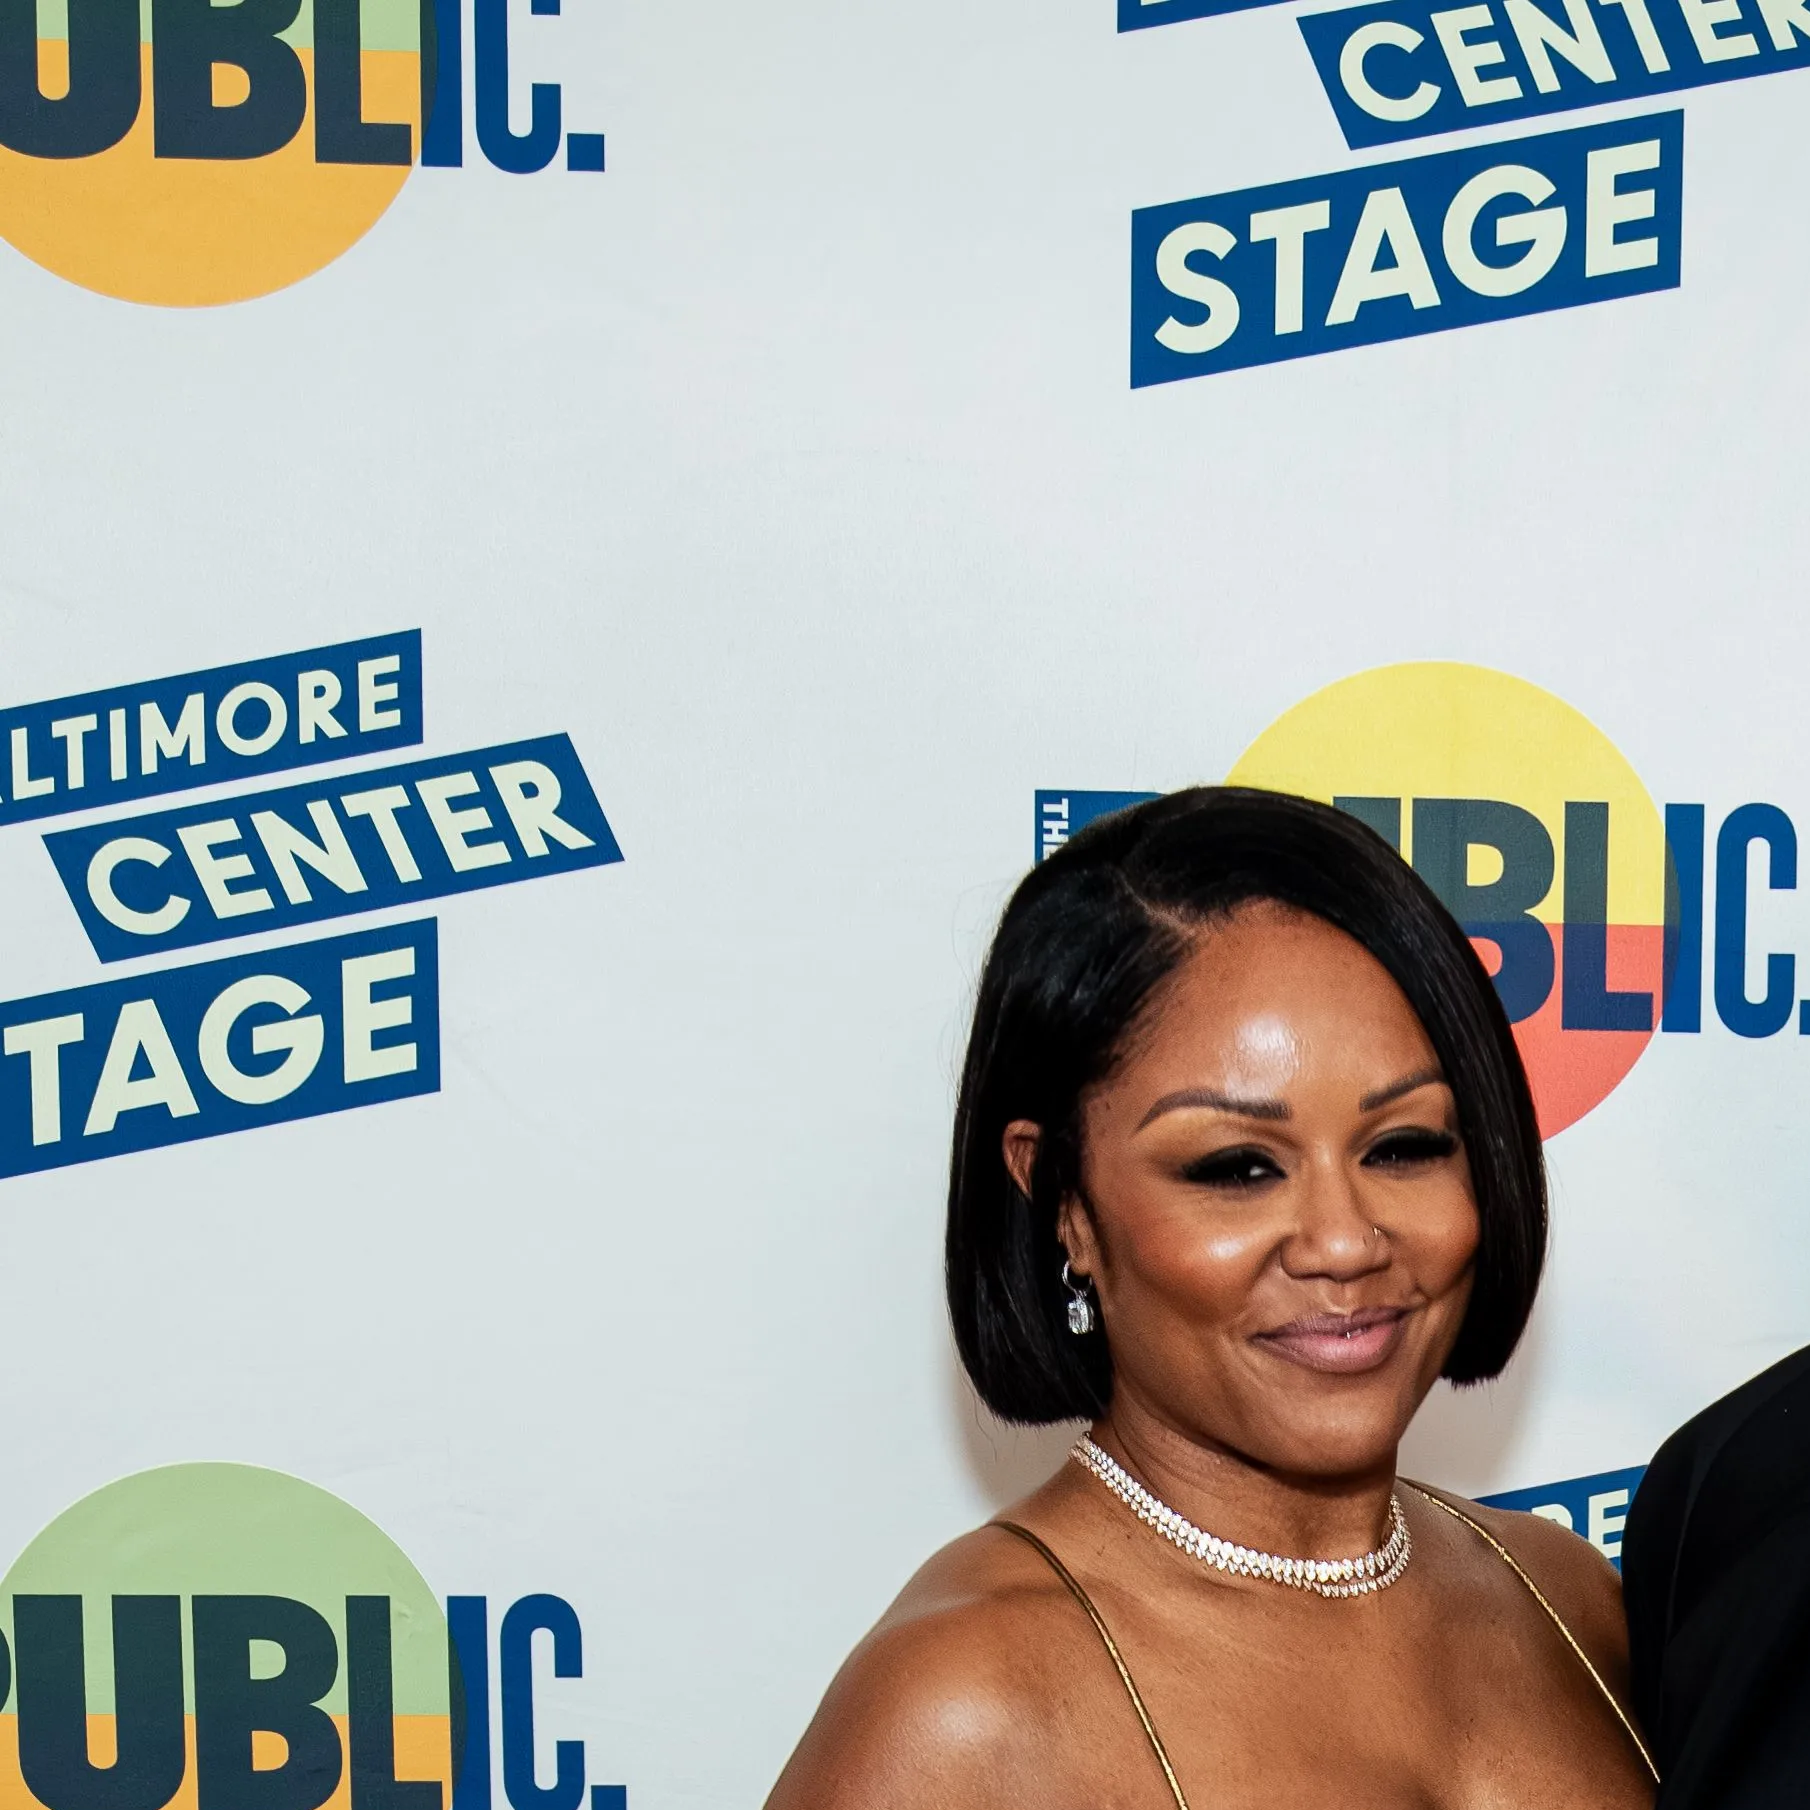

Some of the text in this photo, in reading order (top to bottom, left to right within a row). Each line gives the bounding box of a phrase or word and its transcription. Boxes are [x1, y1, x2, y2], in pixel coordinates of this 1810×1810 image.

[1154, 139, 1661, 354] STAGE
[0, 654, 401, 801] LTIMORE
[87, 760, 596, 935] CENTER
[3, 946, 418, 1146] TAGE
